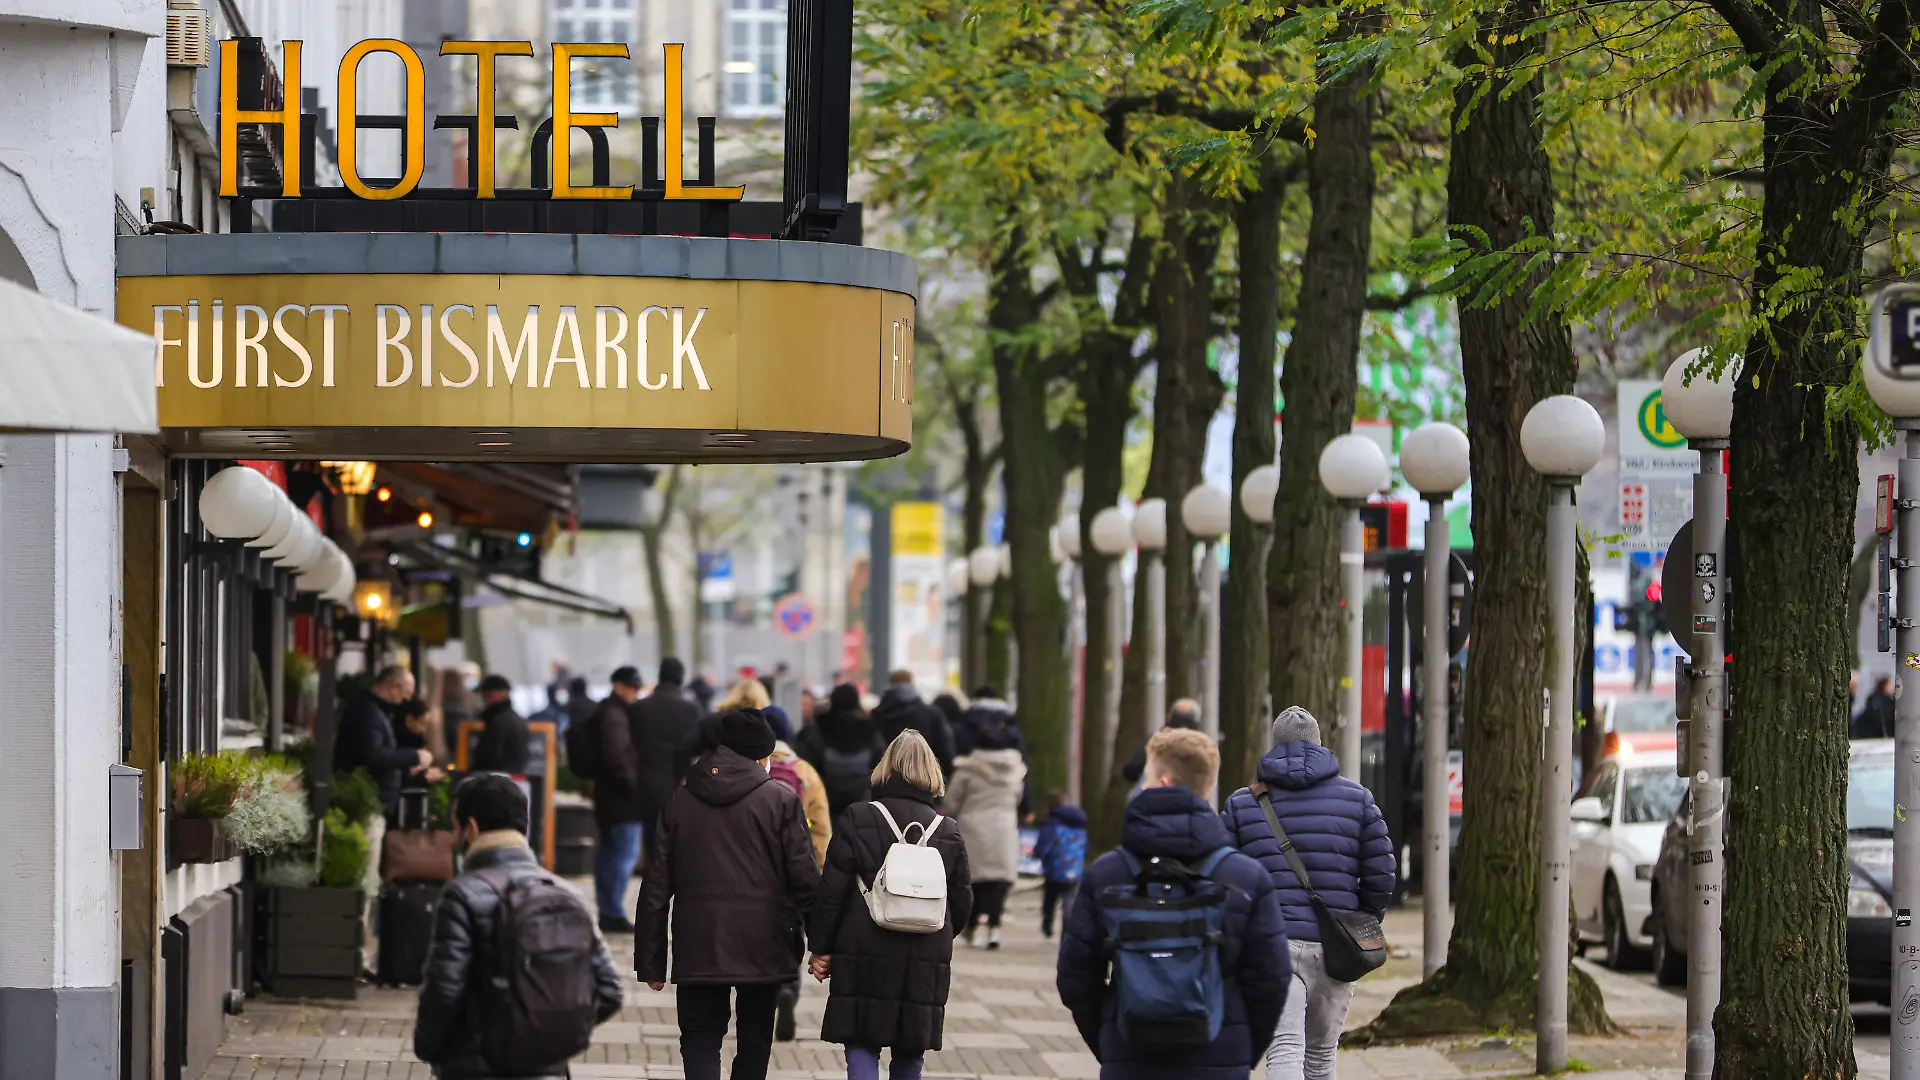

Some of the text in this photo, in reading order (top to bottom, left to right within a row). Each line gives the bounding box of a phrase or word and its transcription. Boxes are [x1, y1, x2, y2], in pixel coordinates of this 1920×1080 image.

[218, 38, 745, 201] HOTEL
[152, 298, 713, 391] FÜRST BISMARCK
